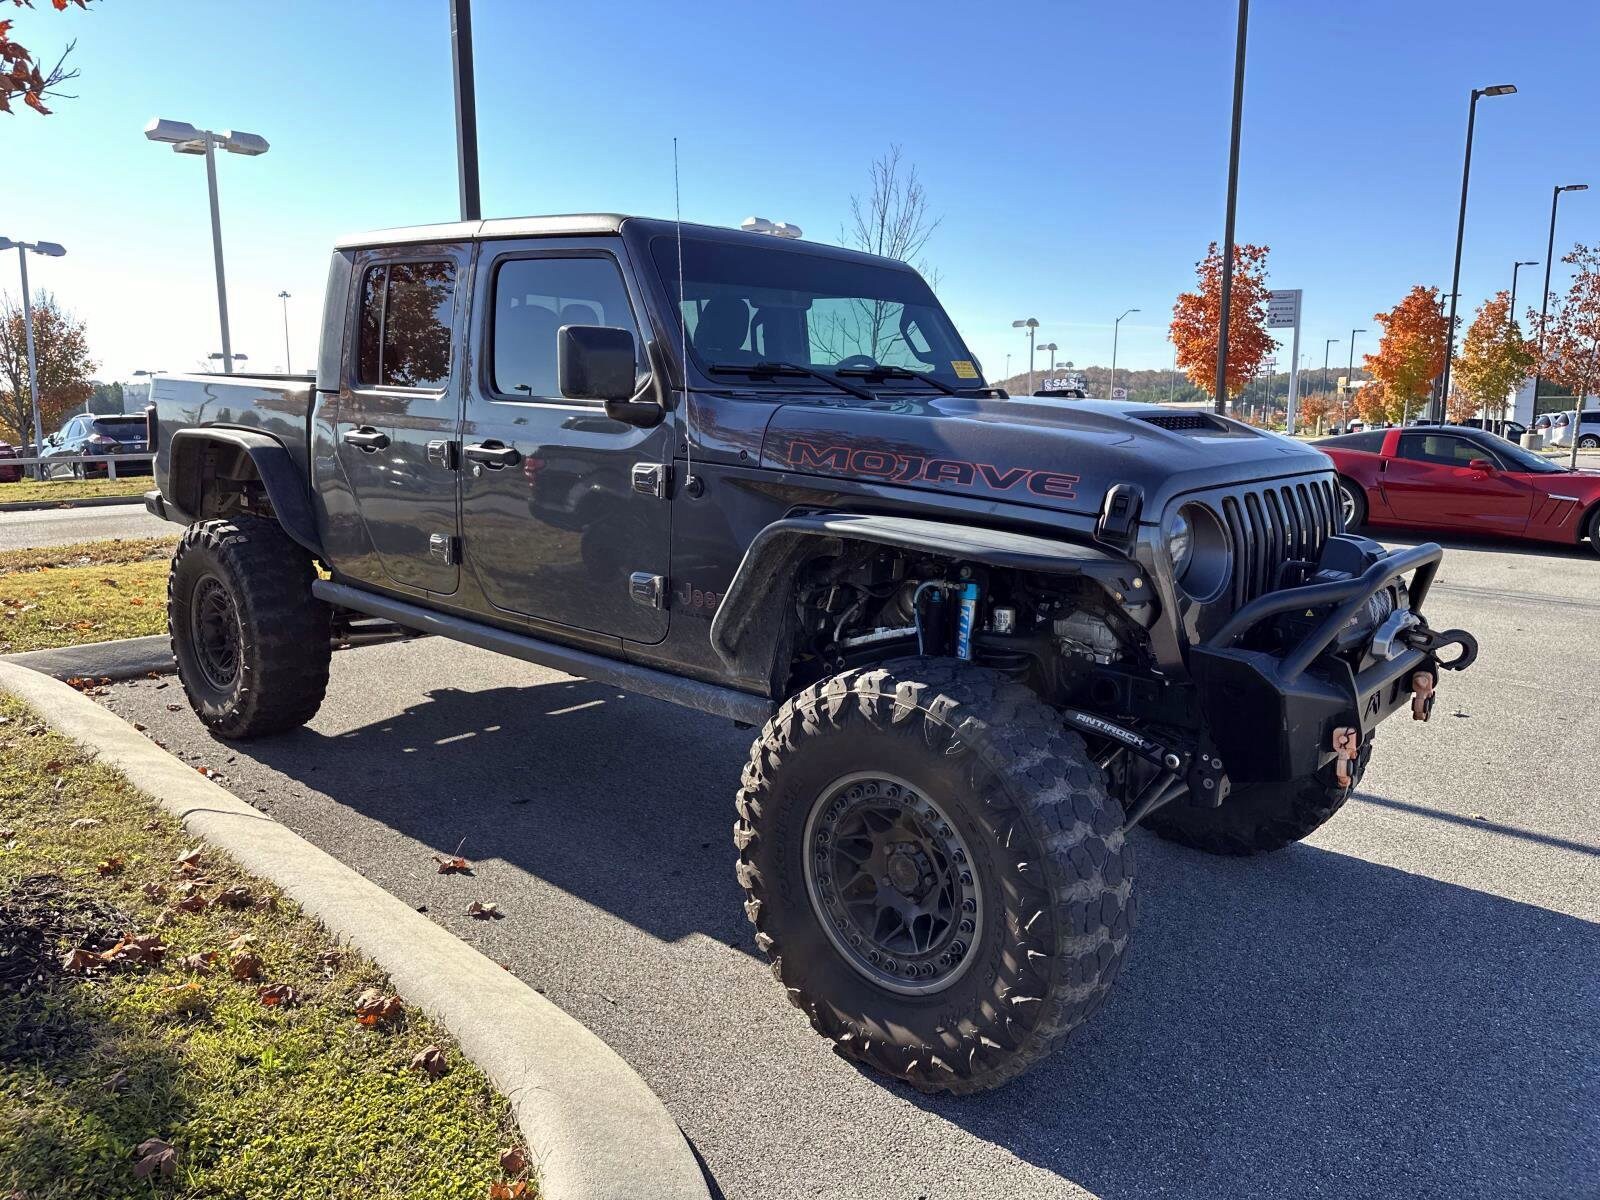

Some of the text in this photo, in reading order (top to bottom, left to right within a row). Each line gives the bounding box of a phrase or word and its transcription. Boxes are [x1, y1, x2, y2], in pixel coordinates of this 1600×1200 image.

[787, 441, 1081, 500] MOJAVE
[957, 607, 969, 658] KING
[1076, 713, 1144, 746] ANTIROCK
